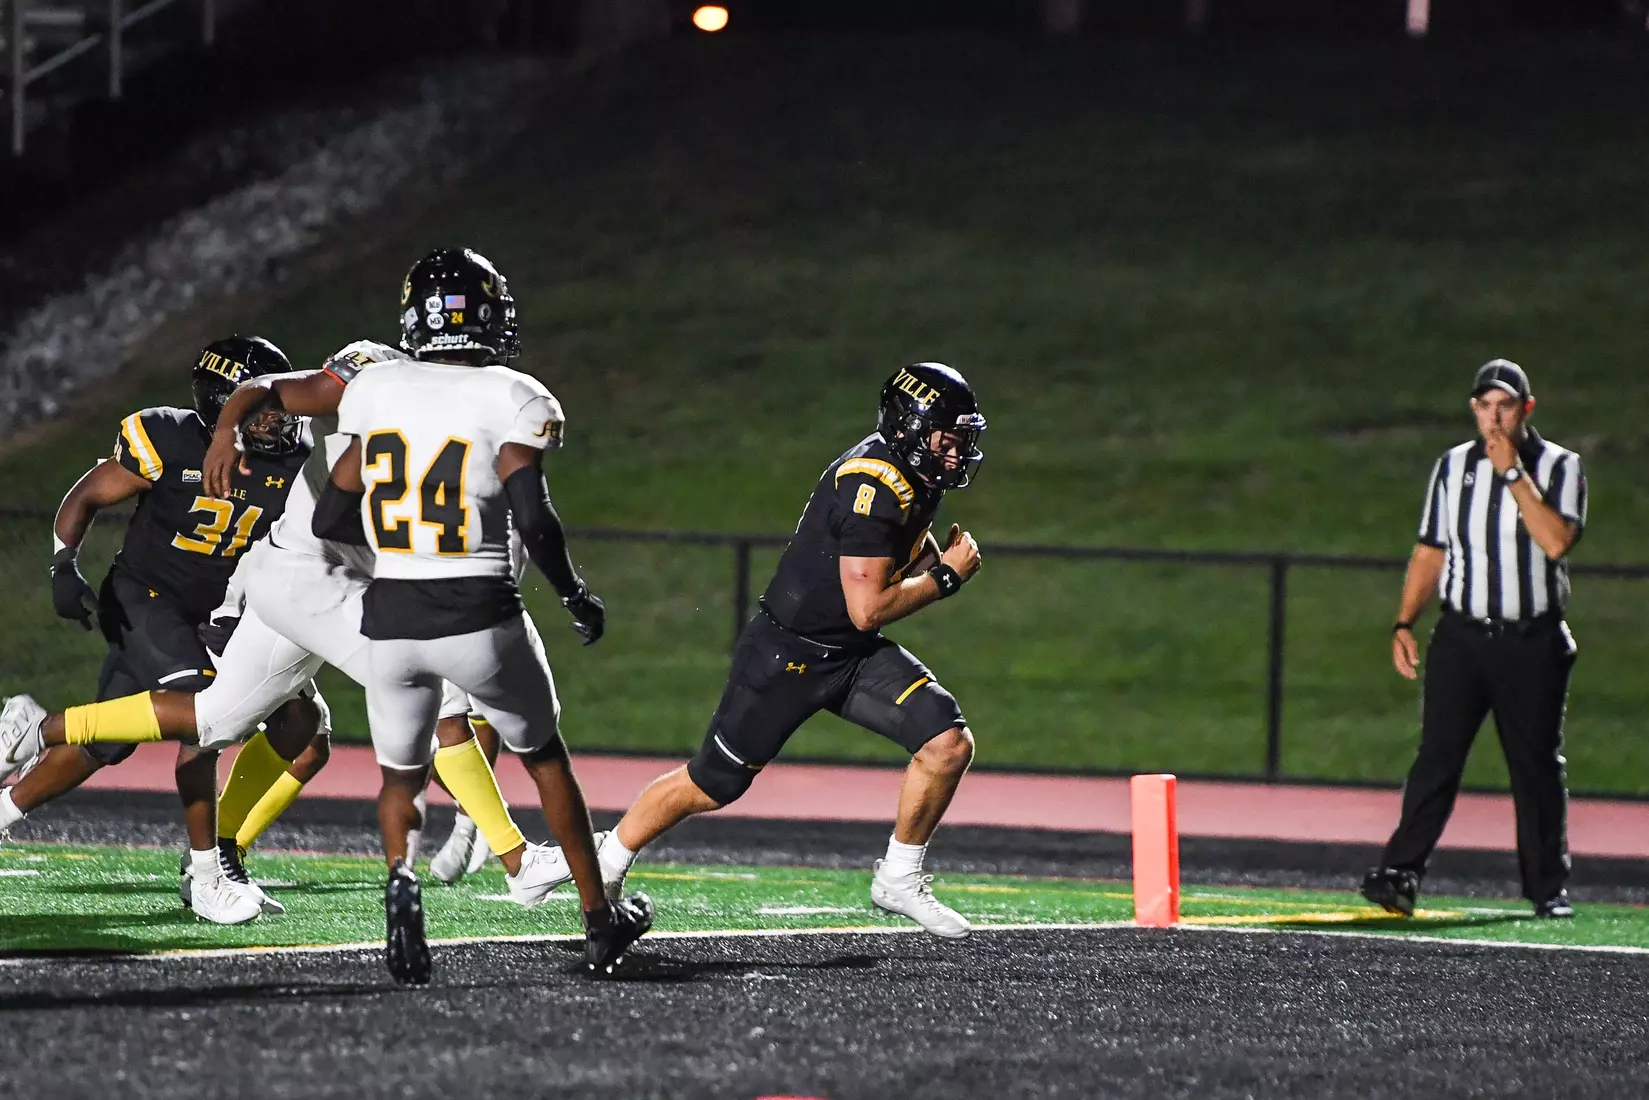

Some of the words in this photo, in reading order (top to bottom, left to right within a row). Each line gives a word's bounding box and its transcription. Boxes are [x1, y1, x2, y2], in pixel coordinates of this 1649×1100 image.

[451, 311, 463, 324] 24
[431, 333, 469, 345] schutt
[199, 350, 245, 383] VILLE
[892, 367, 941, 411] VILLE
[365, 428, 473, 556] 24
[853, 483, 876, 516] 8
[171, 496, 263, 557] 31
